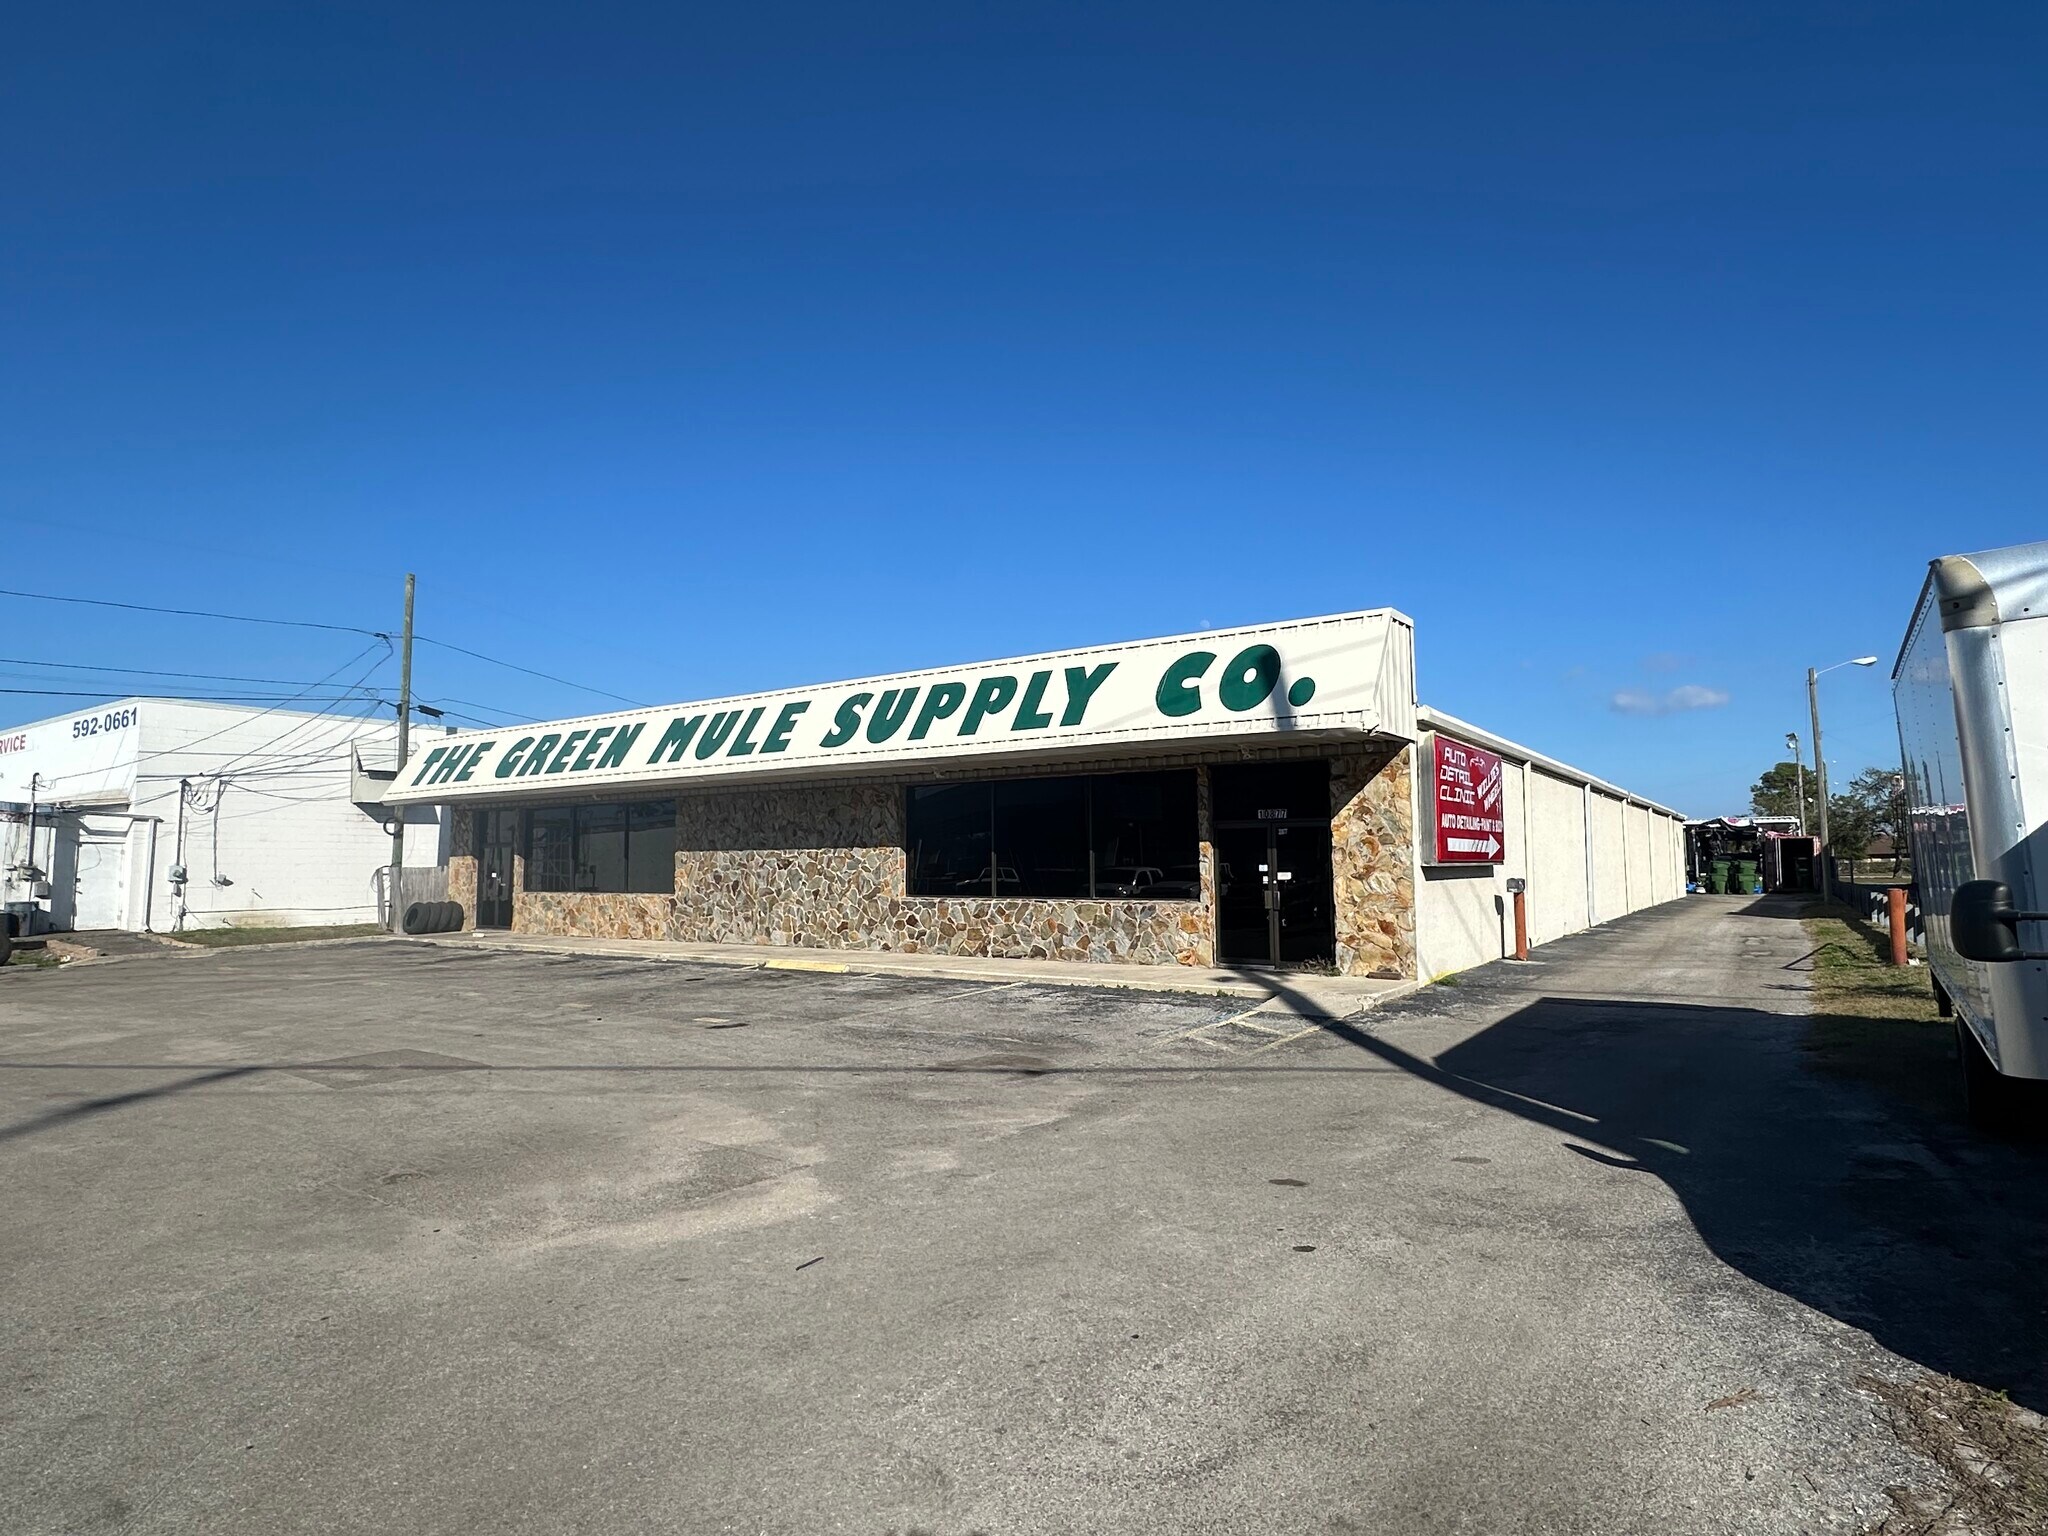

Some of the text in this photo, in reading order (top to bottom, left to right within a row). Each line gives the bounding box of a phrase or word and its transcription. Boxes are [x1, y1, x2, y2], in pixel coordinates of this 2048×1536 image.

[73, 708, 137, 739] 592-0661
[411, 645, 1316, 786] THE GREEN MULE SUPPLY CO.
[1444, 747, 1466, 766] AUTO
[1440, 765, 1473, 786] DETAIL
[1440, 785, 1475, 805] CLINIC
[1441, 813, 1456, 829] AUTO
